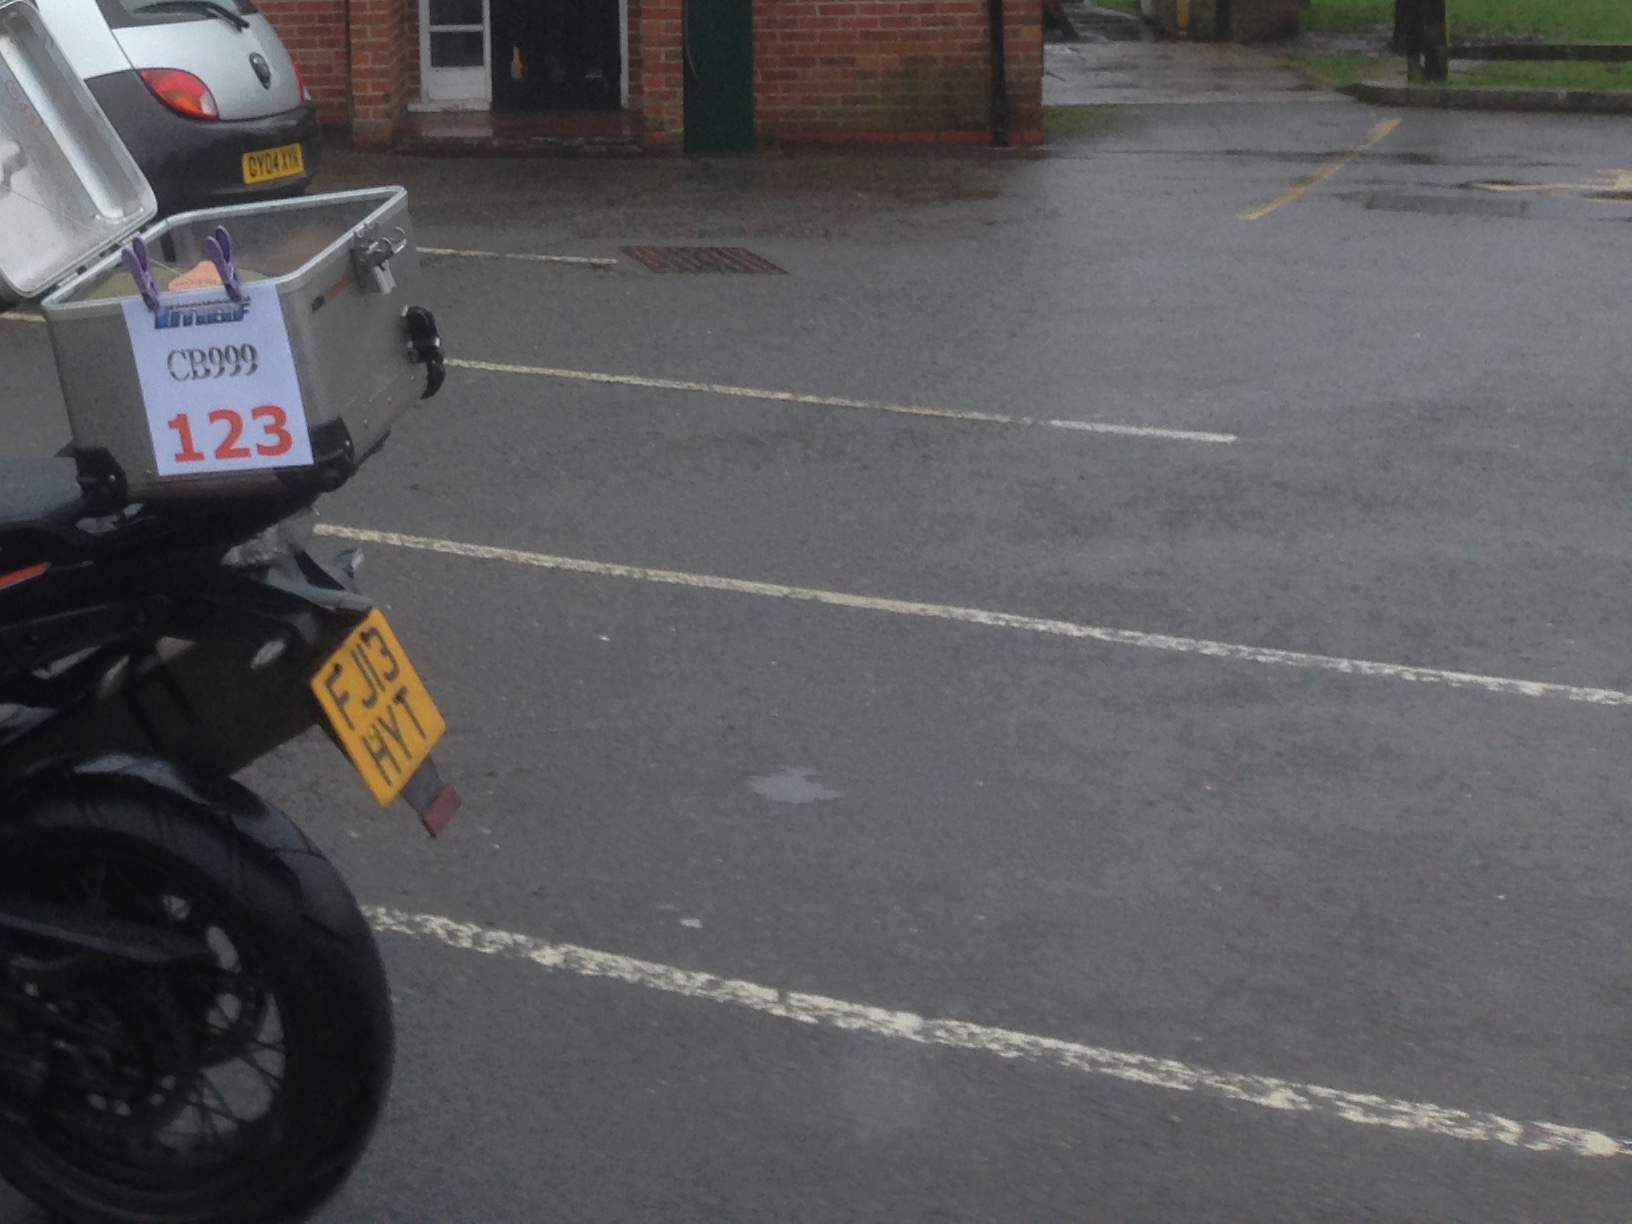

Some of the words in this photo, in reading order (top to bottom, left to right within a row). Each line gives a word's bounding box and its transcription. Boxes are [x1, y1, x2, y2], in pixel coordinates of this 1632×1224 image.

[166, 342, 259, 382] CB999
[167, 404, 294, 463] 123
[324, 626, 402, 730] FJ13
[364, 685, 428, 789] HYT
